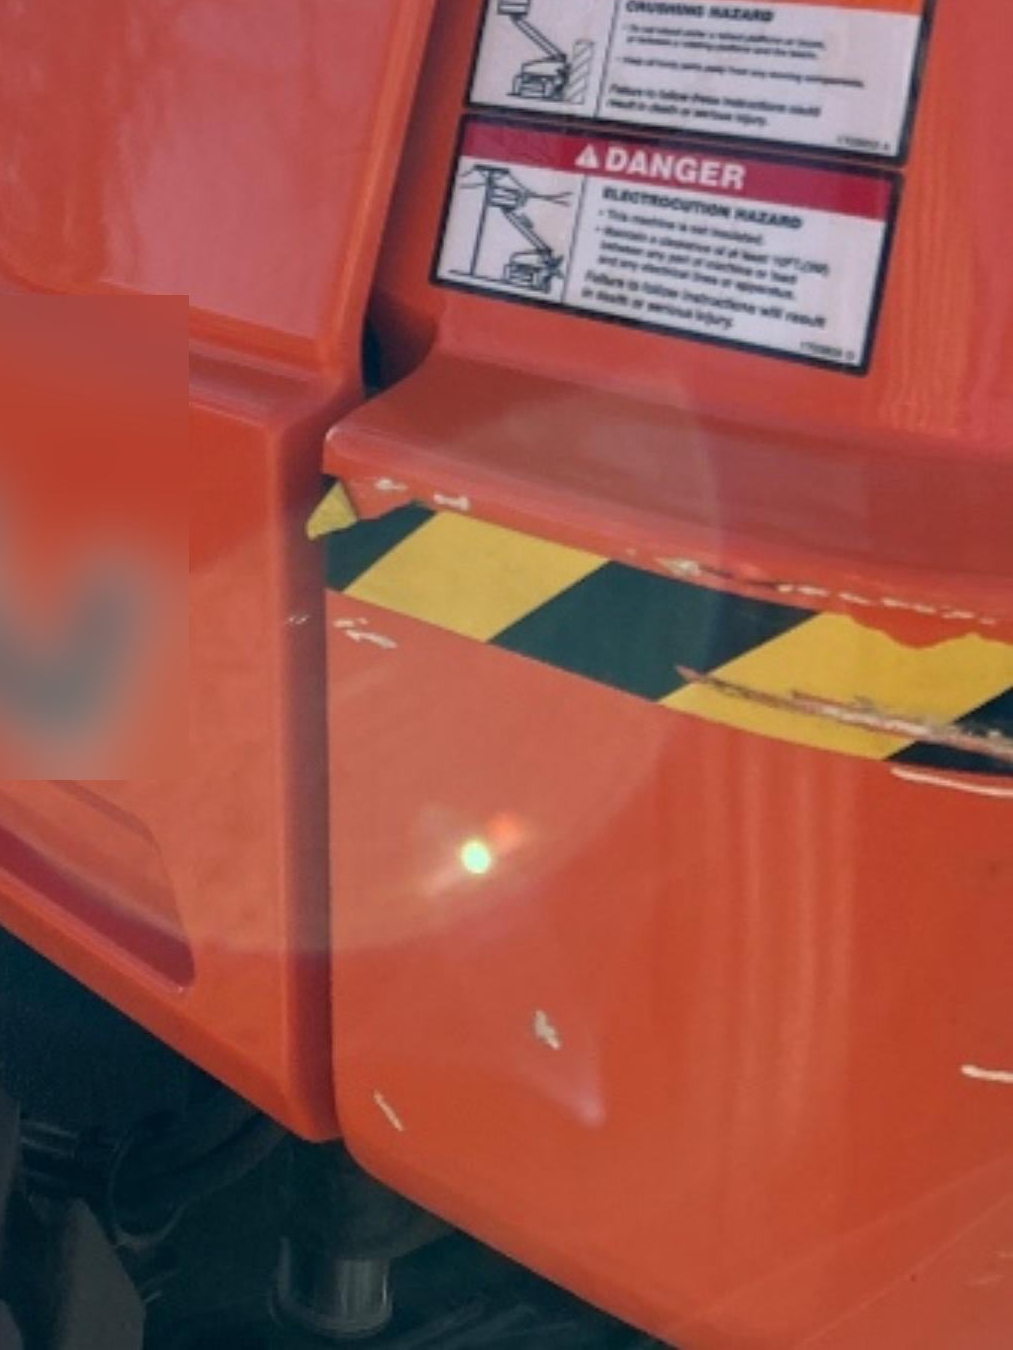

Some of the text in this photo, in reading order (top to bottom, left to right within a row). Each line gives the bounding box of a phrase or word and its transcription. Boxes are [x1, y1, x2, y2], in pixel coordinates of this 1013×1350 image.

[625, 0, 774, 23] CRUSHING HAZARD
[605, 149, 745, 191] DANGER
[602, 186, 803, 229] ELECTROCUTION HAZARD
